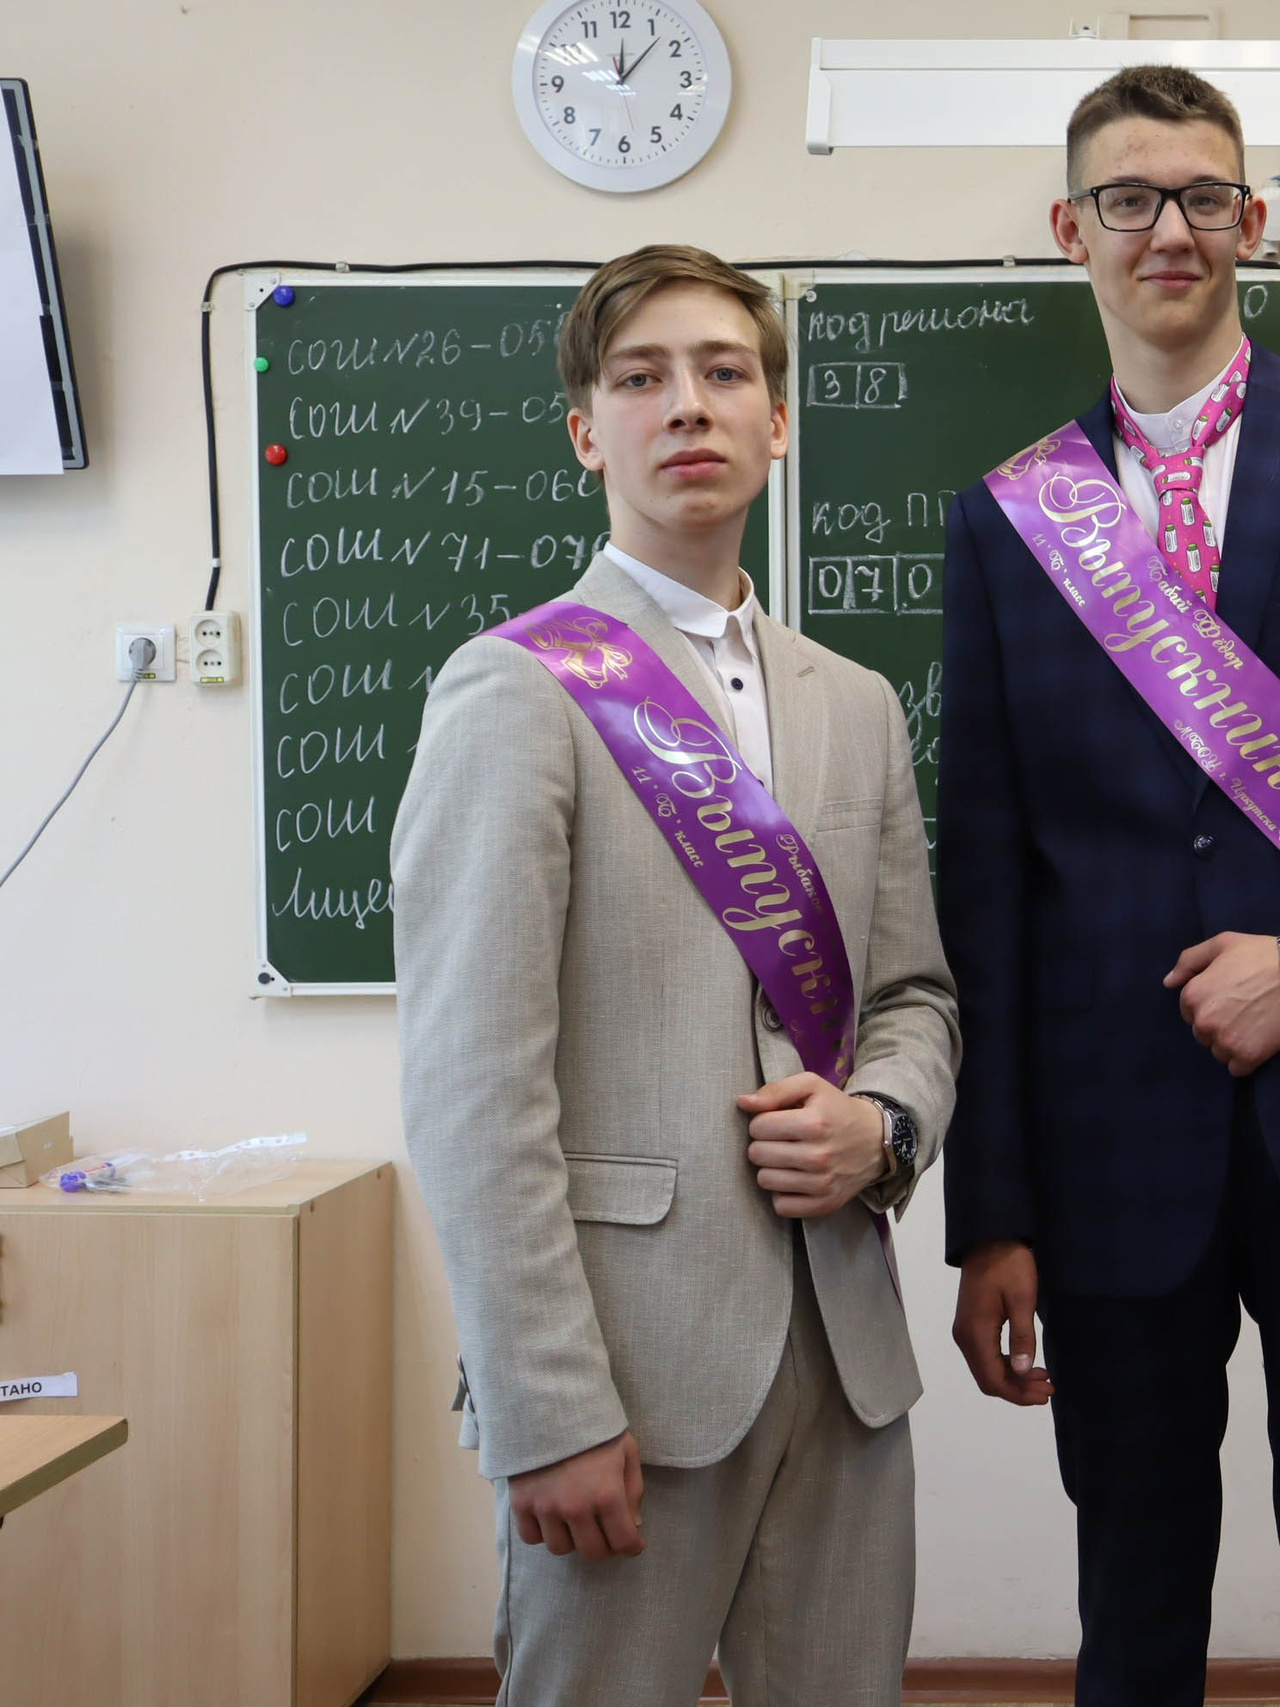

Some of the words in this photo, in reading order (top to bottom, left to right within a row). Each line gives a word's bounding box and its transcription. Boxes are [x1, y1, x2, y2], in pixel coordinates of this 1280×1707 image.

[609, 10, 631, 29] 12
[647, 18, 655, 36] 1
[581, 20, 598, 39] 11
[668, 40, 682, 58] 2
[551, 75, 565, 93] 9
[679, 70, 693, 89] 3
[563, 106, 576, 124] 8
[669, 103, 683, 121] 4
[589, 128, 601, 146] 7
[650, 126, 662, 144] 5
[618, 136, 631, 154] 6
[1063, 578, 1085, 607] класс
[632, 765, 653, 784] 11
[674, 830, 704, 868] класс
